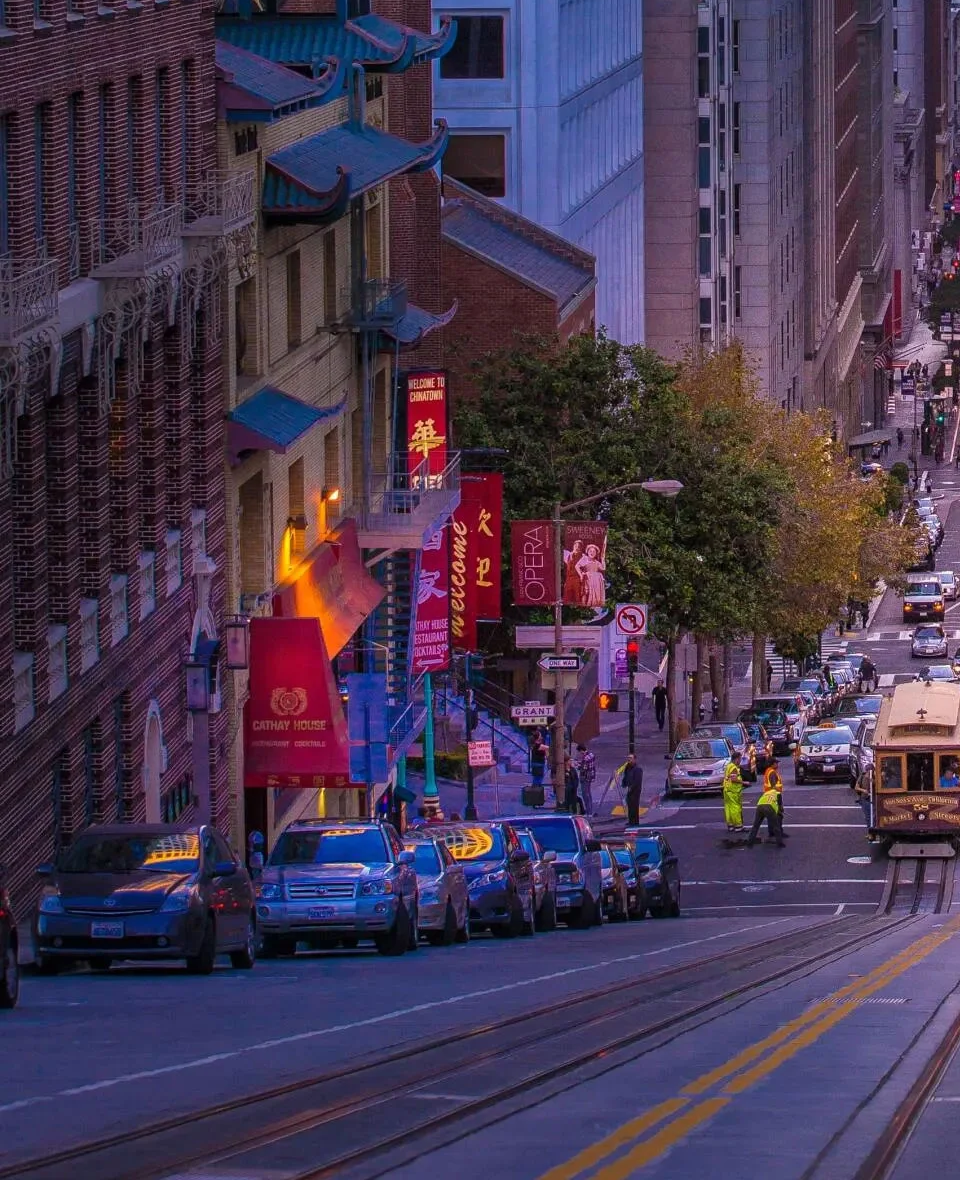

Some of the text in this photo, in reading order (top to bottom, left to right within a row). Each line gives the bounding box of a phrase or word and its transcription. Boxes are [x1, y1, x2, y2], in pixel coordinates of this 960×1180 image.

[408, 376, 445, 390] WELCOME TO
[409, 389, 443, 403] CHINATOWN
[567, 525, 605, 535] SWEENEY
[523, 525, 546, 601] OPERA
[415, 618, 449, 631] THAY HOUSE
[414, 631, 447, 645] ESTAURANT
[414, 644, 442, 658] OCKTAILS
[515, 707, 551, 715] GRANT
[252, 720, 327, 731] CATHAY HOUSE
[808, 745, 842, 754] 1327
